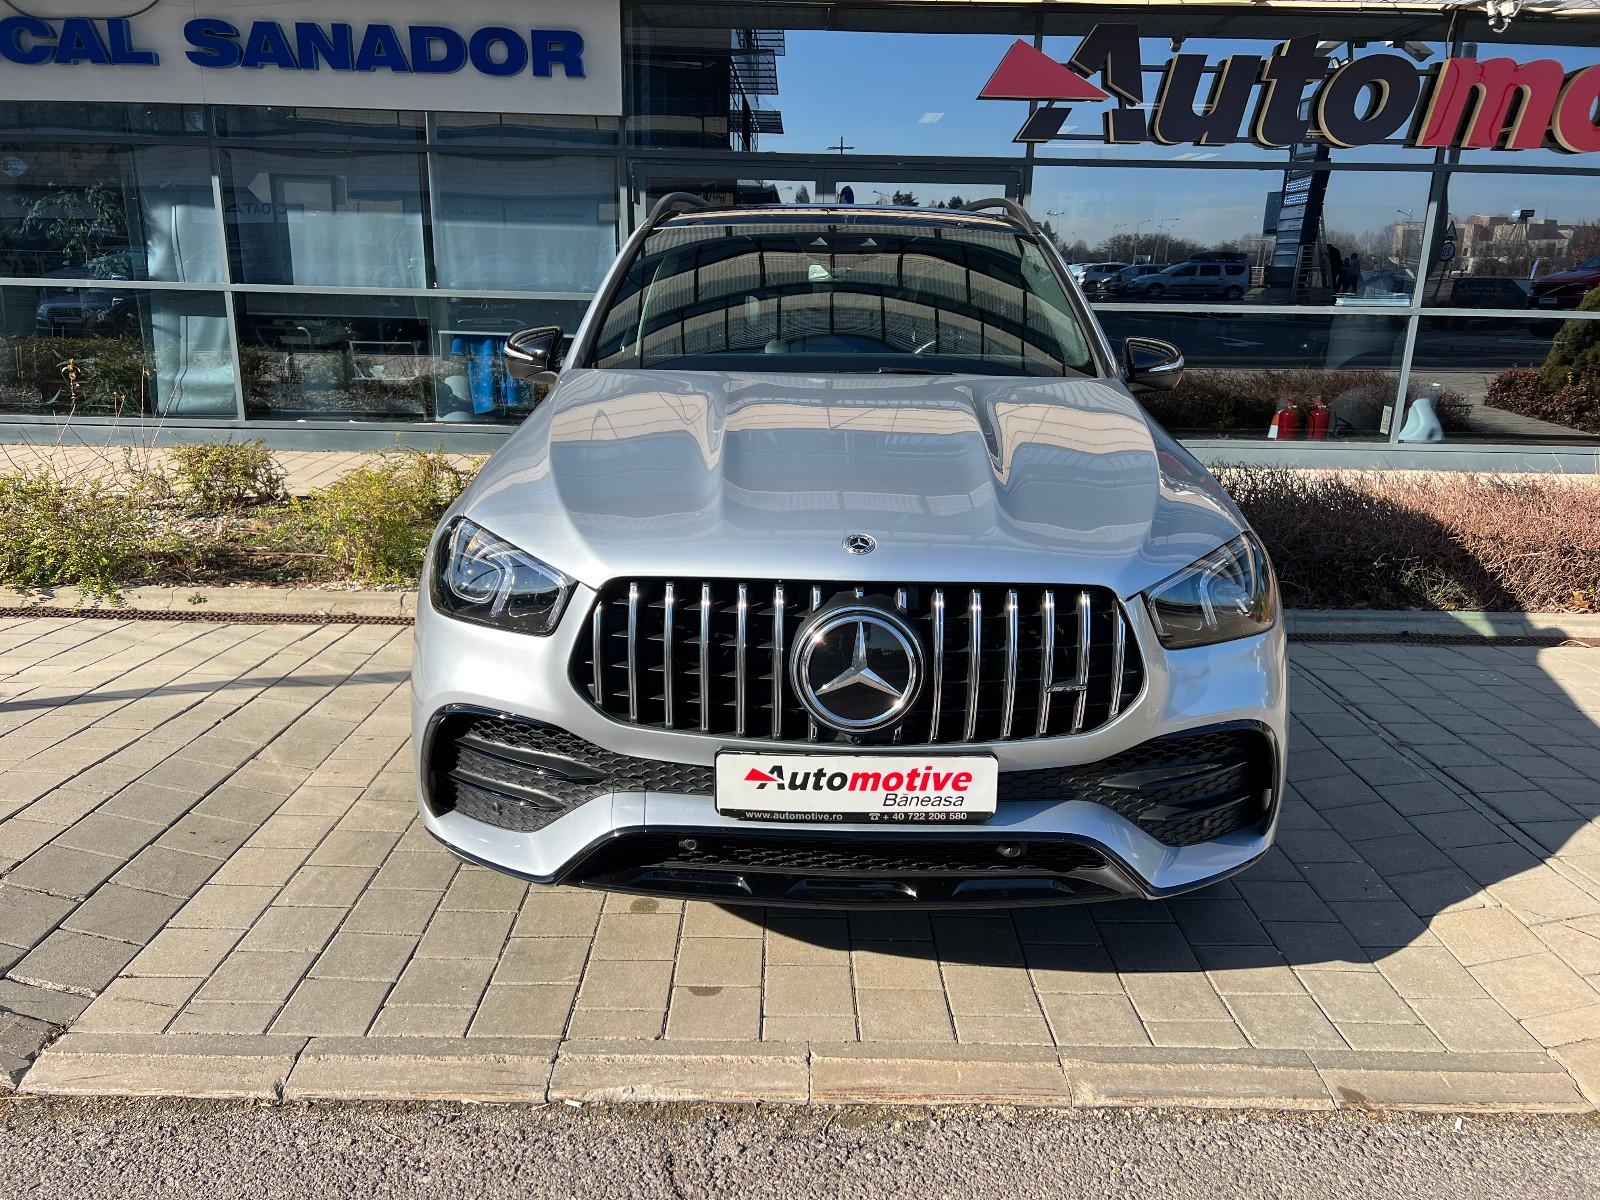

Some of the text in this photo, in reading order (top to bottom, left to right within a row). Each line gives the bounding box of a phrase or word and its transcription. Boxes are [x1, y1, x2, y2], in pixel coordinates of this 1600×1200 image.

[0, 16, 586, 78] CAL SANADOR
[744, 765, 972, 791] Automotive
[882, 793, 964, 807] Băneasa
[745, 811, 843, 821] www.automotive.ro
[892, 812, 905, 820] 40
[907, 812, 926, 821] 722
[928, 812, 947, 820] 206
[949, 812, 968, 820] 580
